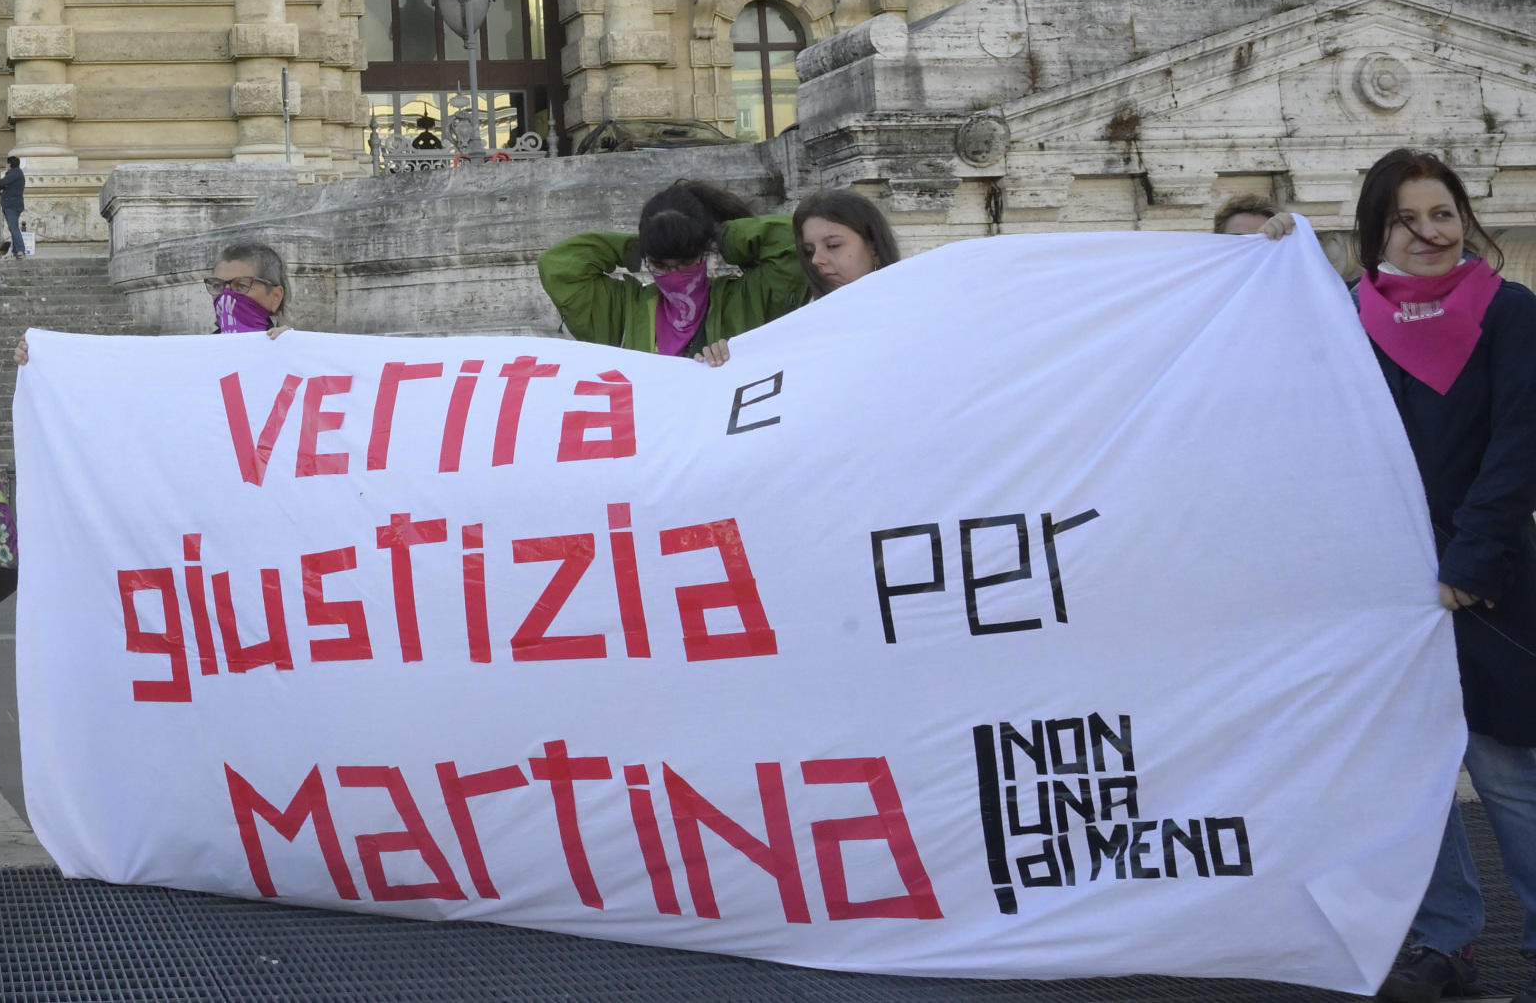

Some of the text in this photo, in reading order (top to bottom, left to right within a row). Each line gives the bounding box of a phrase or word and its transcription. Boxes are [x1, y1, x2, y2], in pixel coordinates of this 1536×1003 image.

[726, 370, 784, 435] e
[999, 711, 1136, 781] NON
[1005, 776, 1140, 836] UNA
[1085, 816, 1253, 881] MENO
